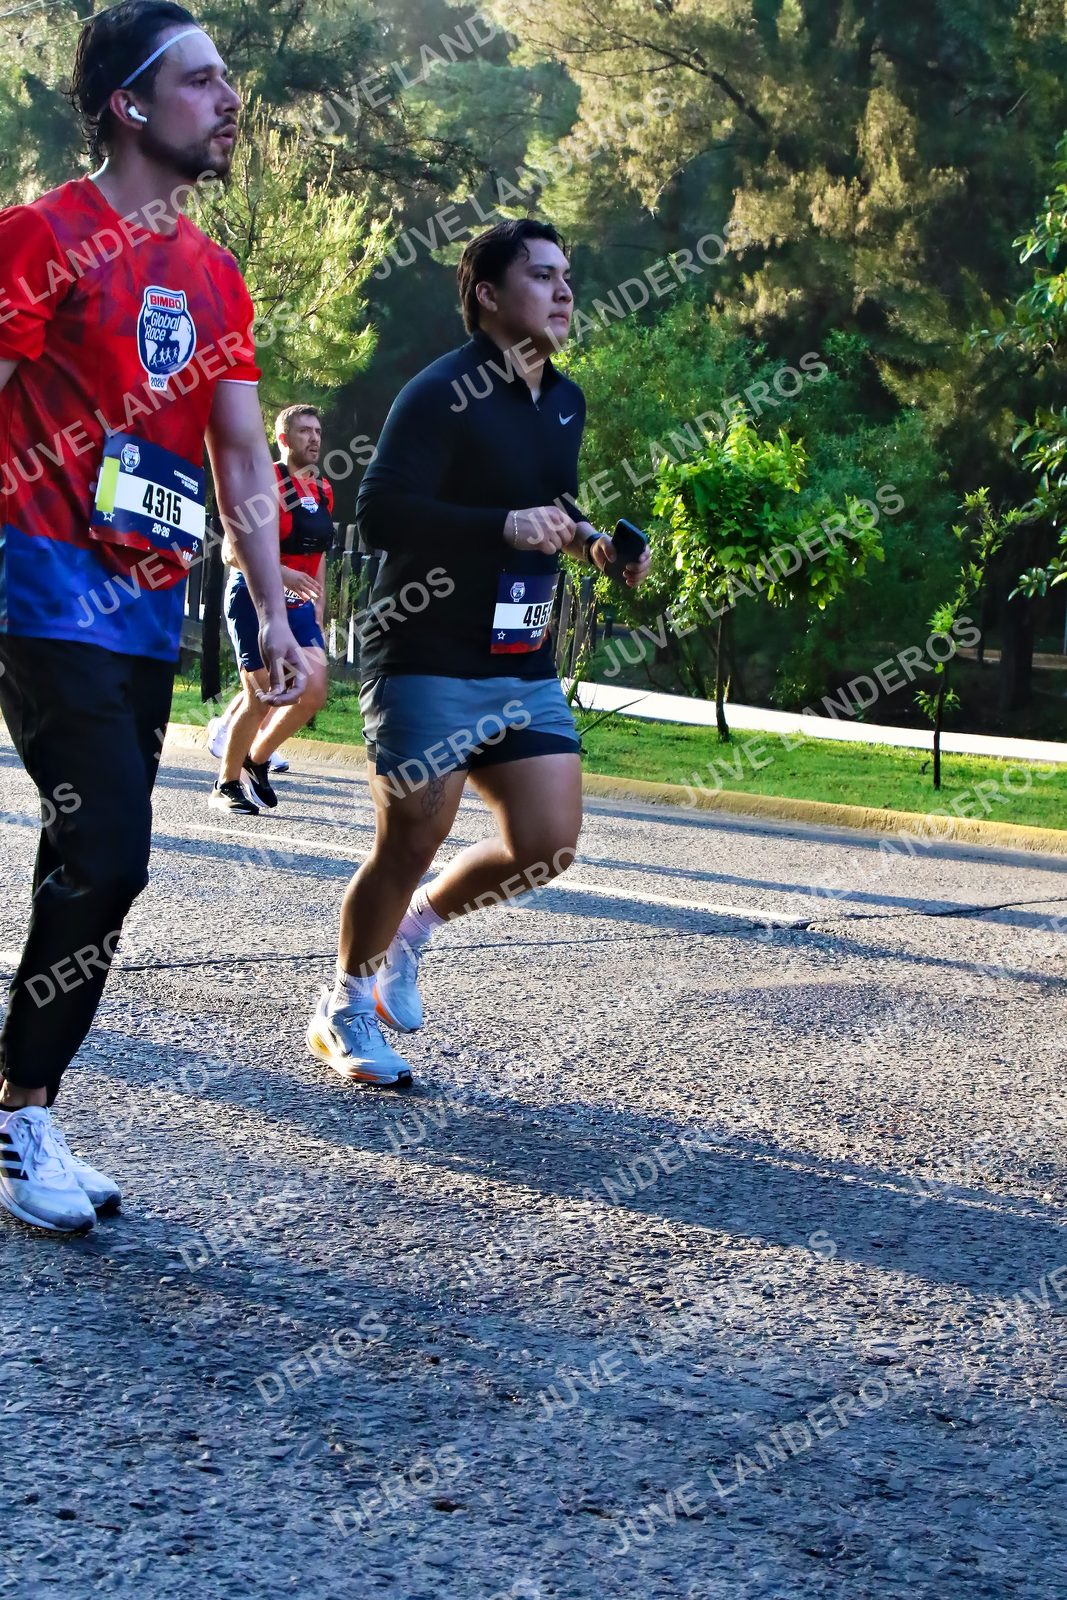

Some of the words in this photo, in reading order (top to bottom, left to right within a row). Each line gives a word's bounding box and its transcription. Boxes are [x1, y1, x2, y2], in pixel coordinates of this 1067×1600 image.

[150, 295, 180, 309] BIMBO
[151, 312, 180, 331] Global
[145, 326, 166, 341] Race
[142, 483, 182, 526] 4315
